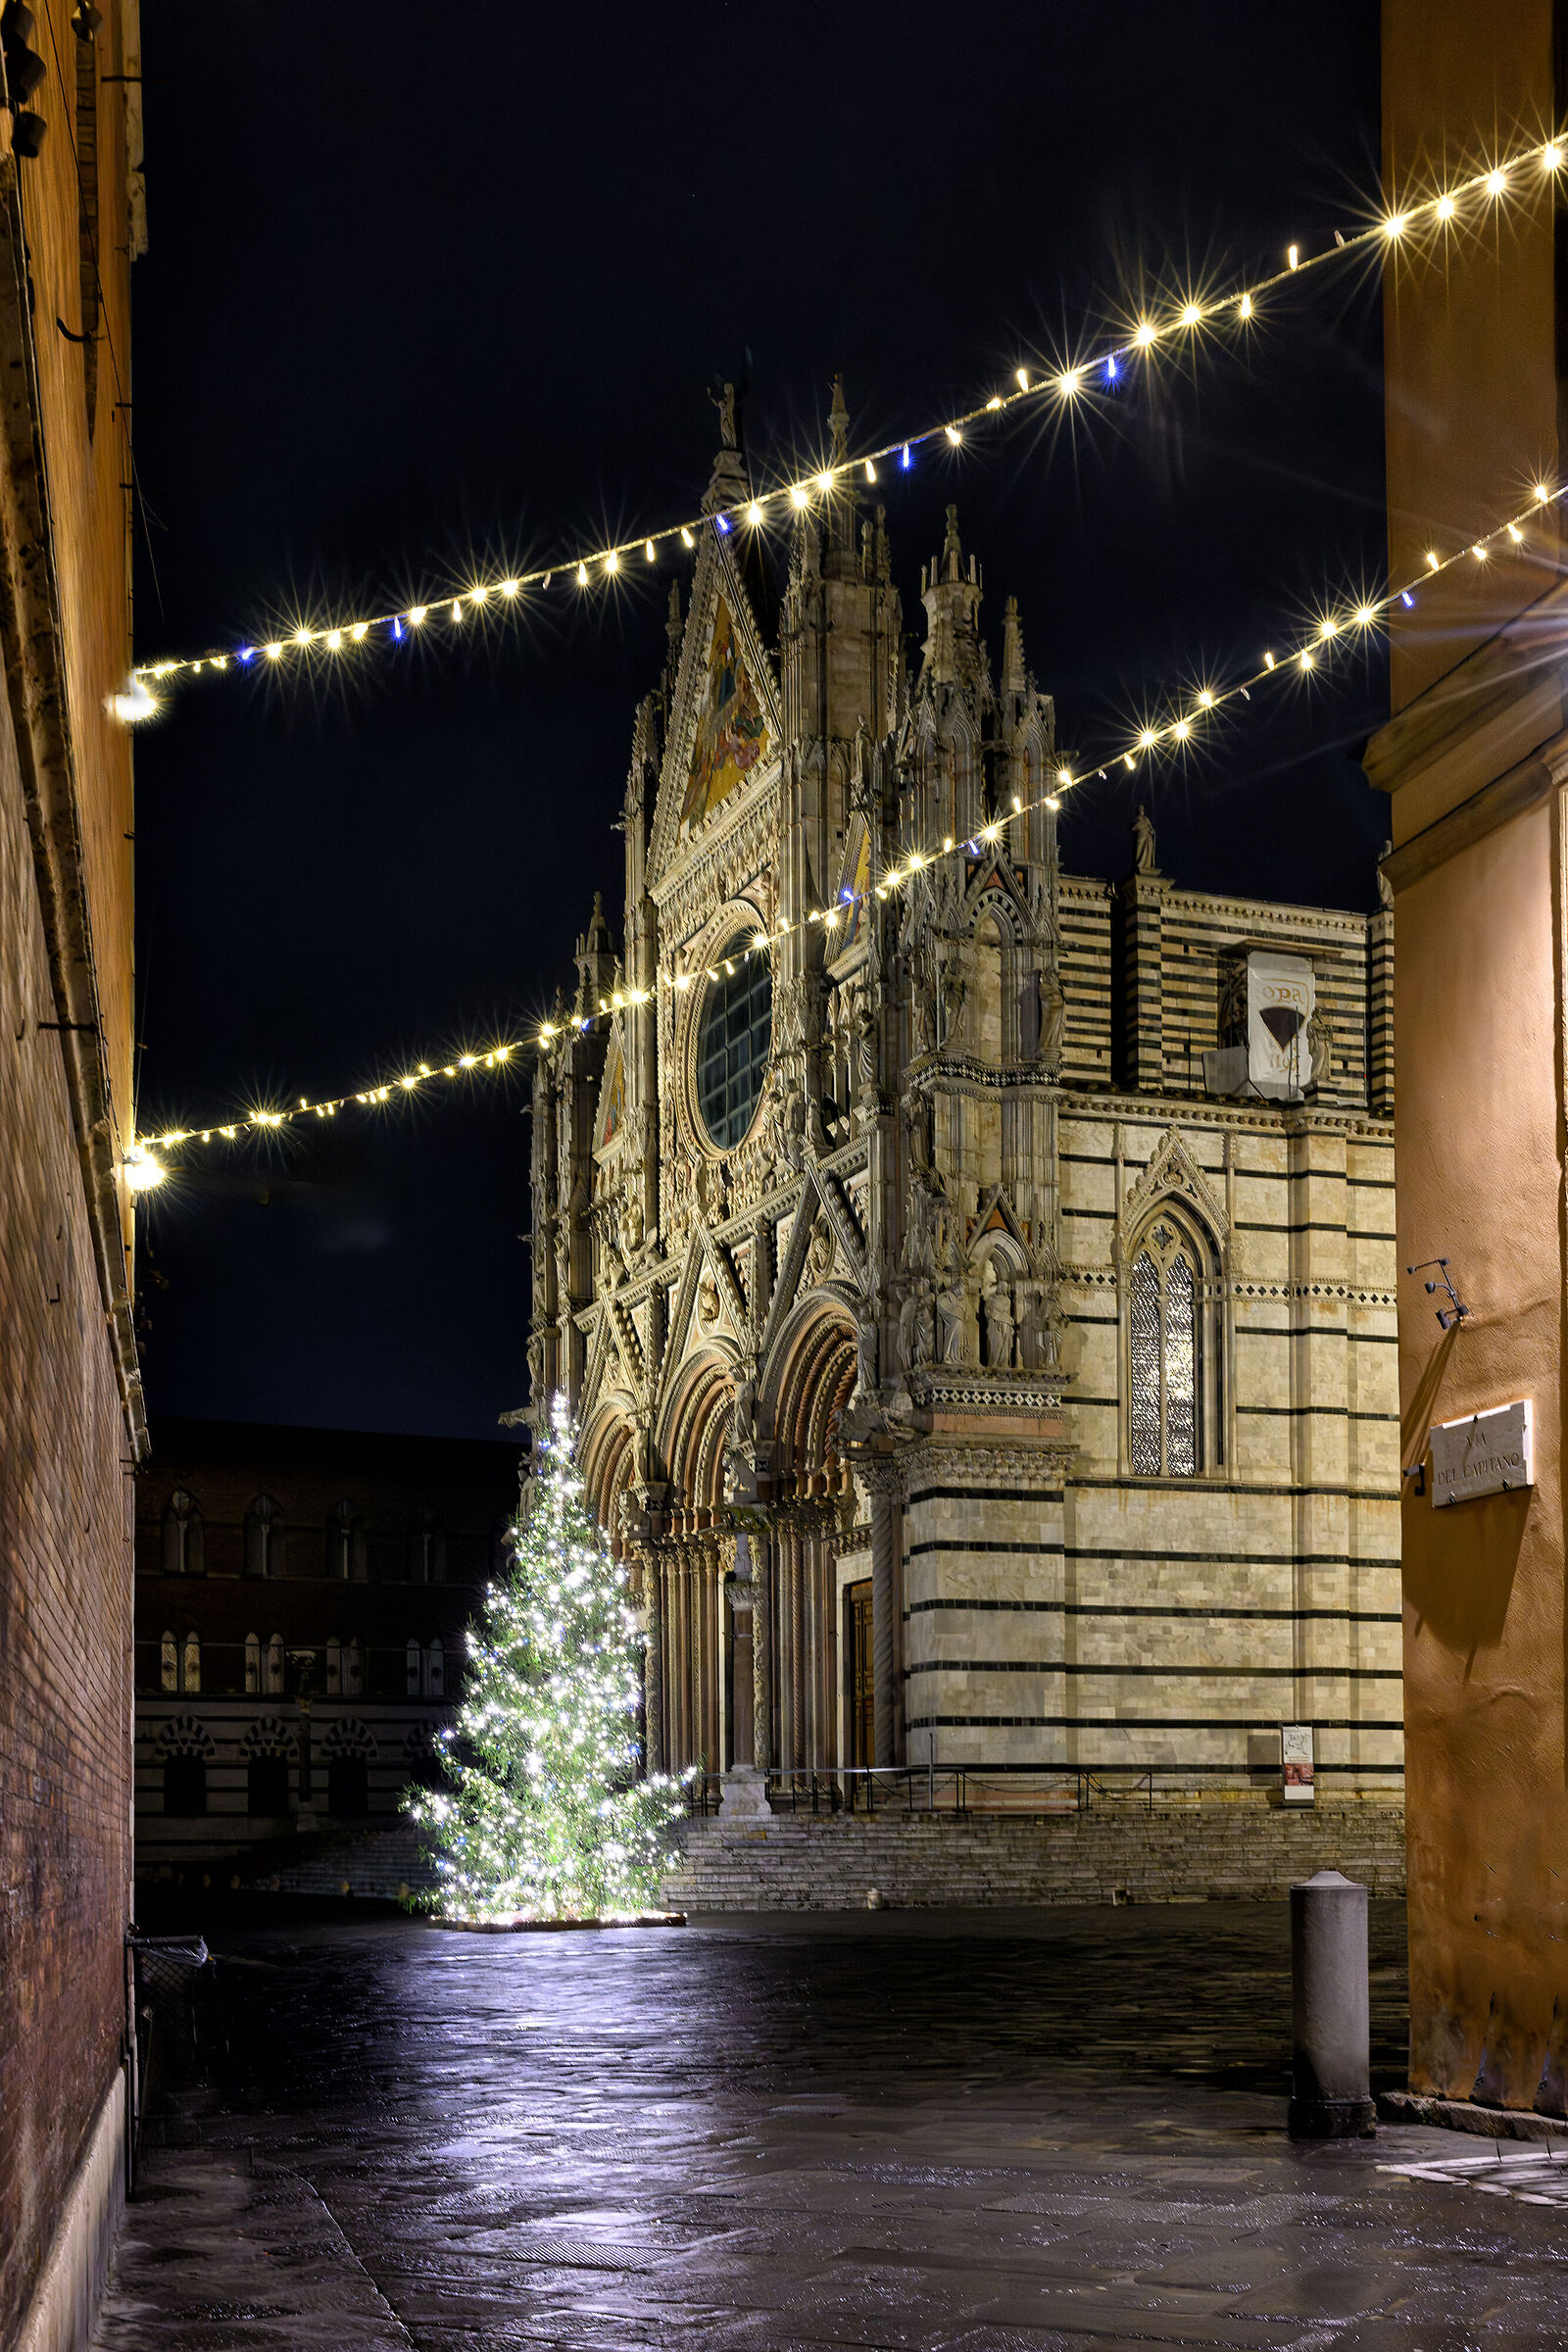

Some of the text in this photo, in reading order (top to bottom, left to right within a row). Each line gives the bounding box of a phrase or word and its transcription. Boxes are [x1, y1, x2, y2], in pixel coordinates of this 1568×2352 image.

[1465, 1432, 1489, 1448] VIA
[1437, 1452, 1520, 1486] DEL CAPITANO
